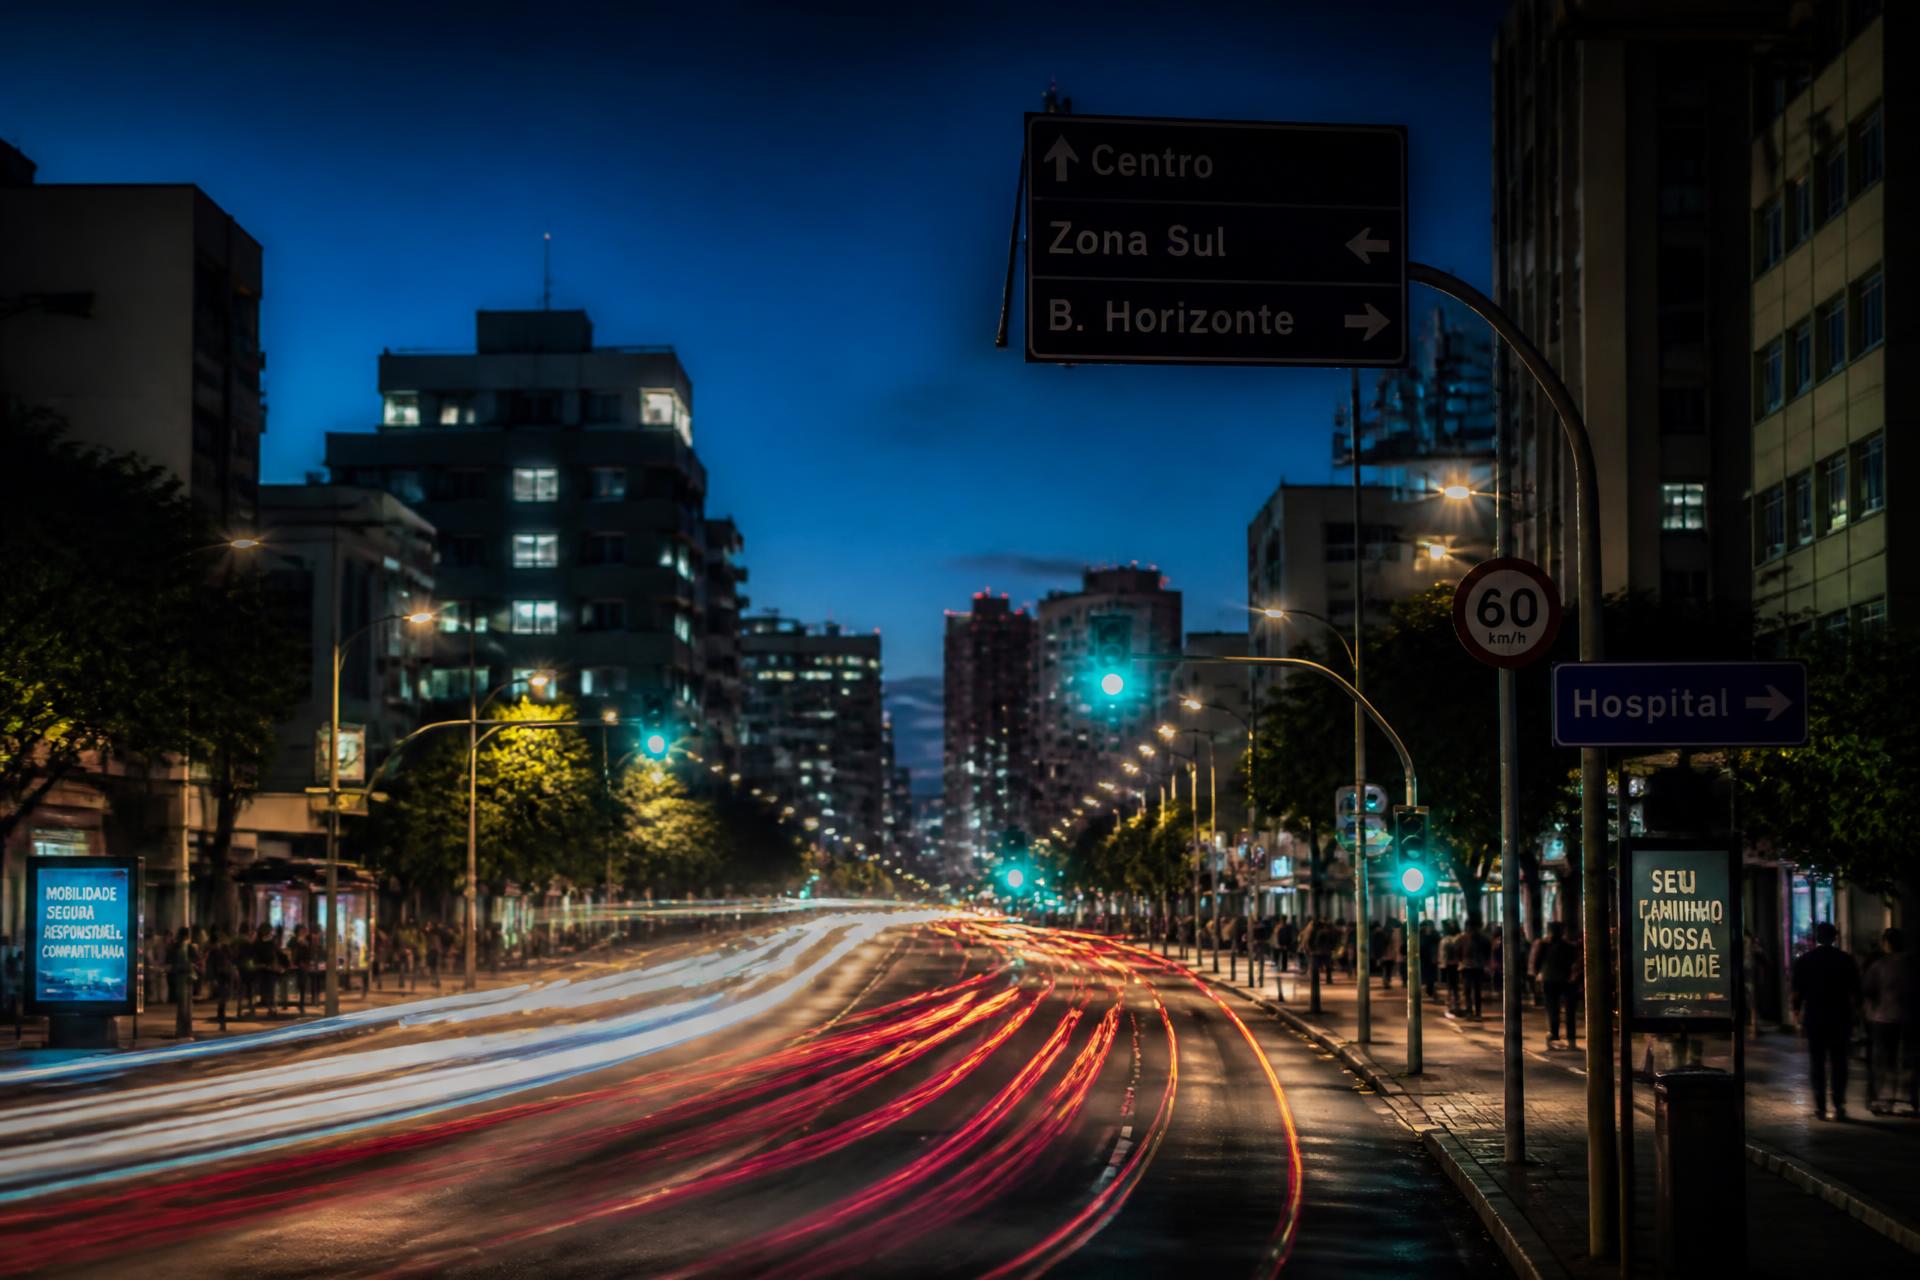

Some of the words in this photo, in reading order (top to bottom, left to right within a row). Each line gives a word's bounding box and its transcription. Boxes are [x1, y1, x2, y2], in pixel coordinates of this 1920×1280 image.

[1091, 144, 1214, 179] Centro
[1048, 220, 1149, 256] Zona
[1167, 224, 1226, 258] Sul
[1049, 298, 1084, 332] B.
[1106, 300, 1295, 335] Horizonte
[1477, 588, 1538, 628] 60
[1488, 631, 1526, 645] km/h
[1573, 688, 1729, 725] Hospital
[46, 886, 117, 901] MOBILIDADE
[1651, 869, 1696, 894] SEU
